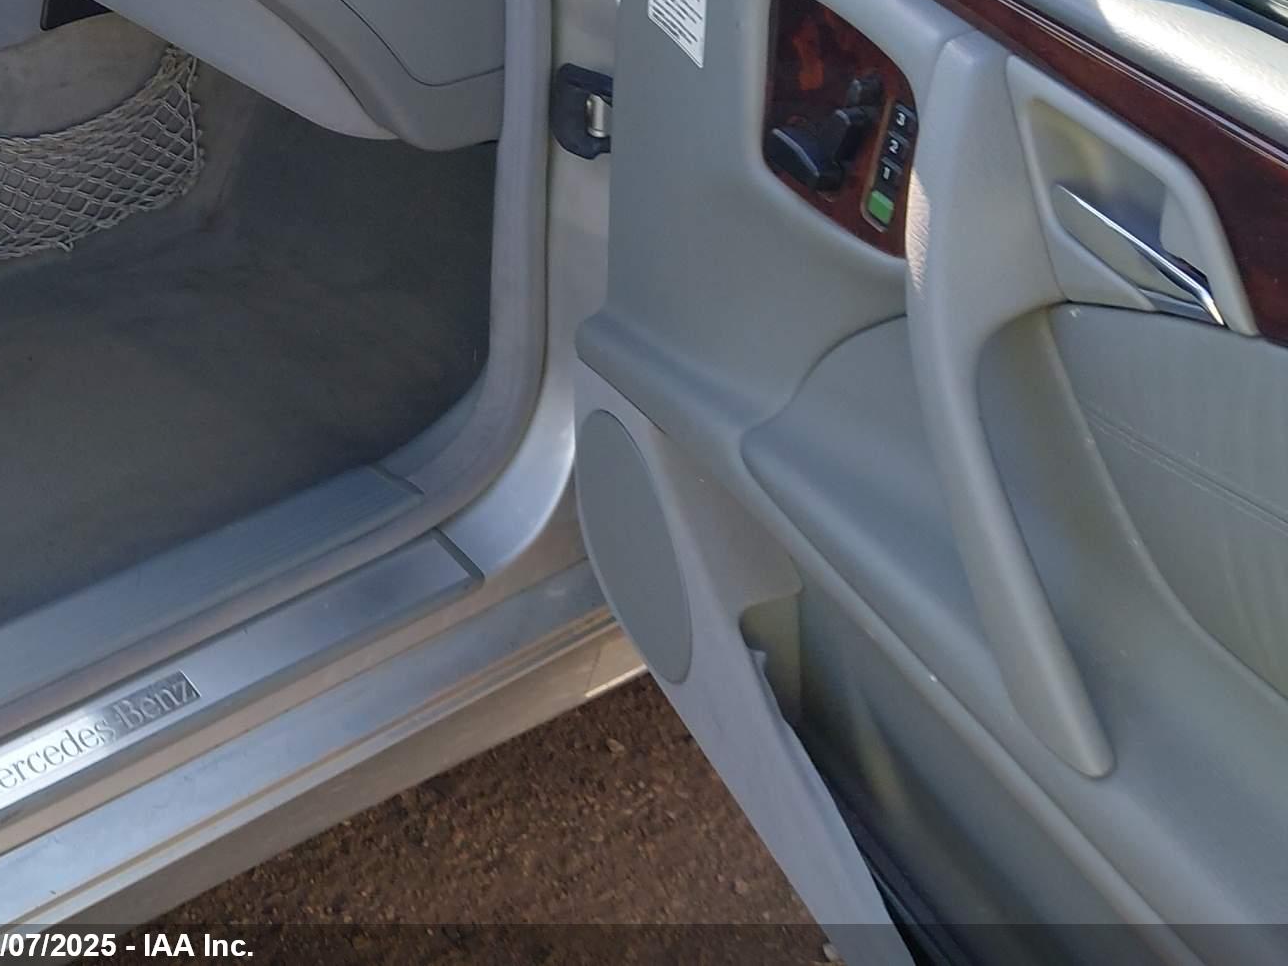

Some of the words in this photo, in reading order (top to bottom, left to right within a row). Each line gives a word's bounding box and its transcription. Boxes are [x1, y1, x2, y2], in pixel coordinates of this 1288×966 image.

[896, 112, 906, 127] 3
[888, 139, 899, 154] 2
[883, 166, 891, 180] 1
[114, 679, 198, 728] Benz
